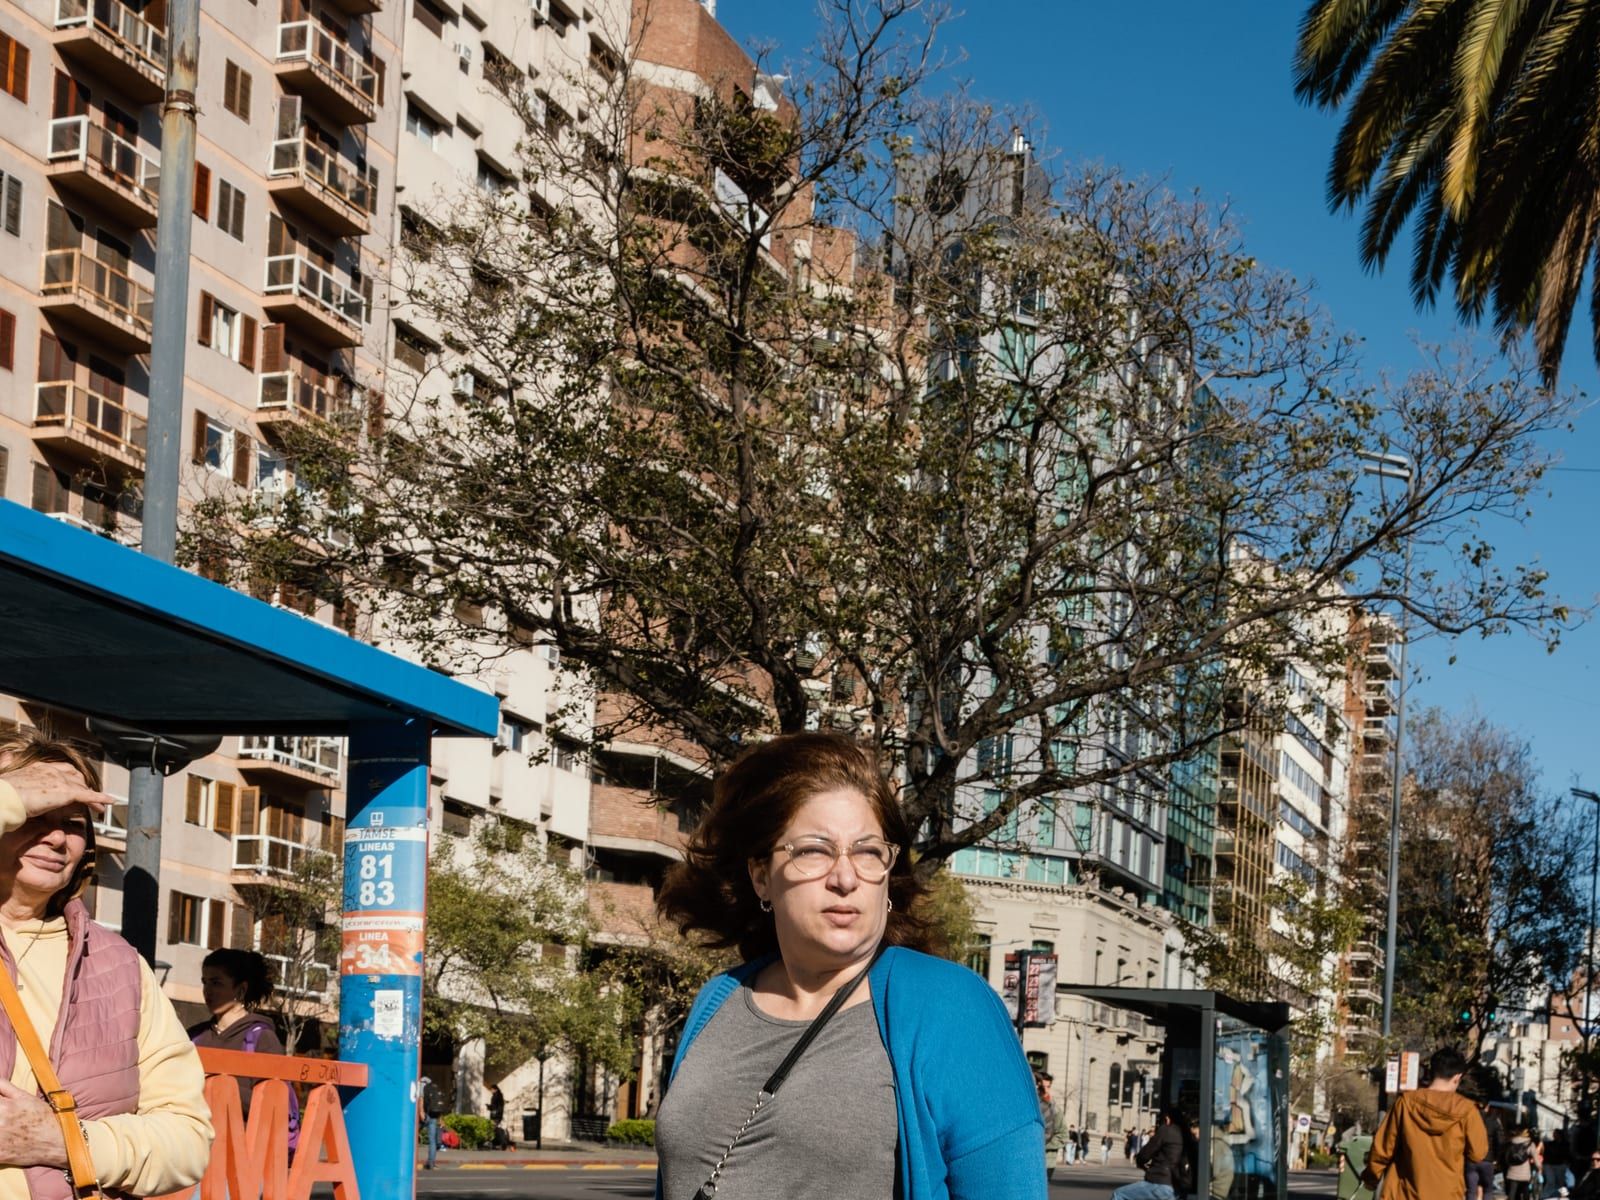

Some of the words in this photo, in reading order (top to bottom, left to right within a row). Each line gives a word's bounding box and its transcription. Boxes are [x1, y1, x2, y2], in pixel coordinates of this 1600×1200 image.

[359, 828, 396, 839] TAMSE
[359, 842, 395, 852] LINEAS
[360, 854, 393, 880] 81
[359, 880, 395, 906] 83
[359, 932, 389, 942] LINEA
[356, 943, 389, 969] 34
